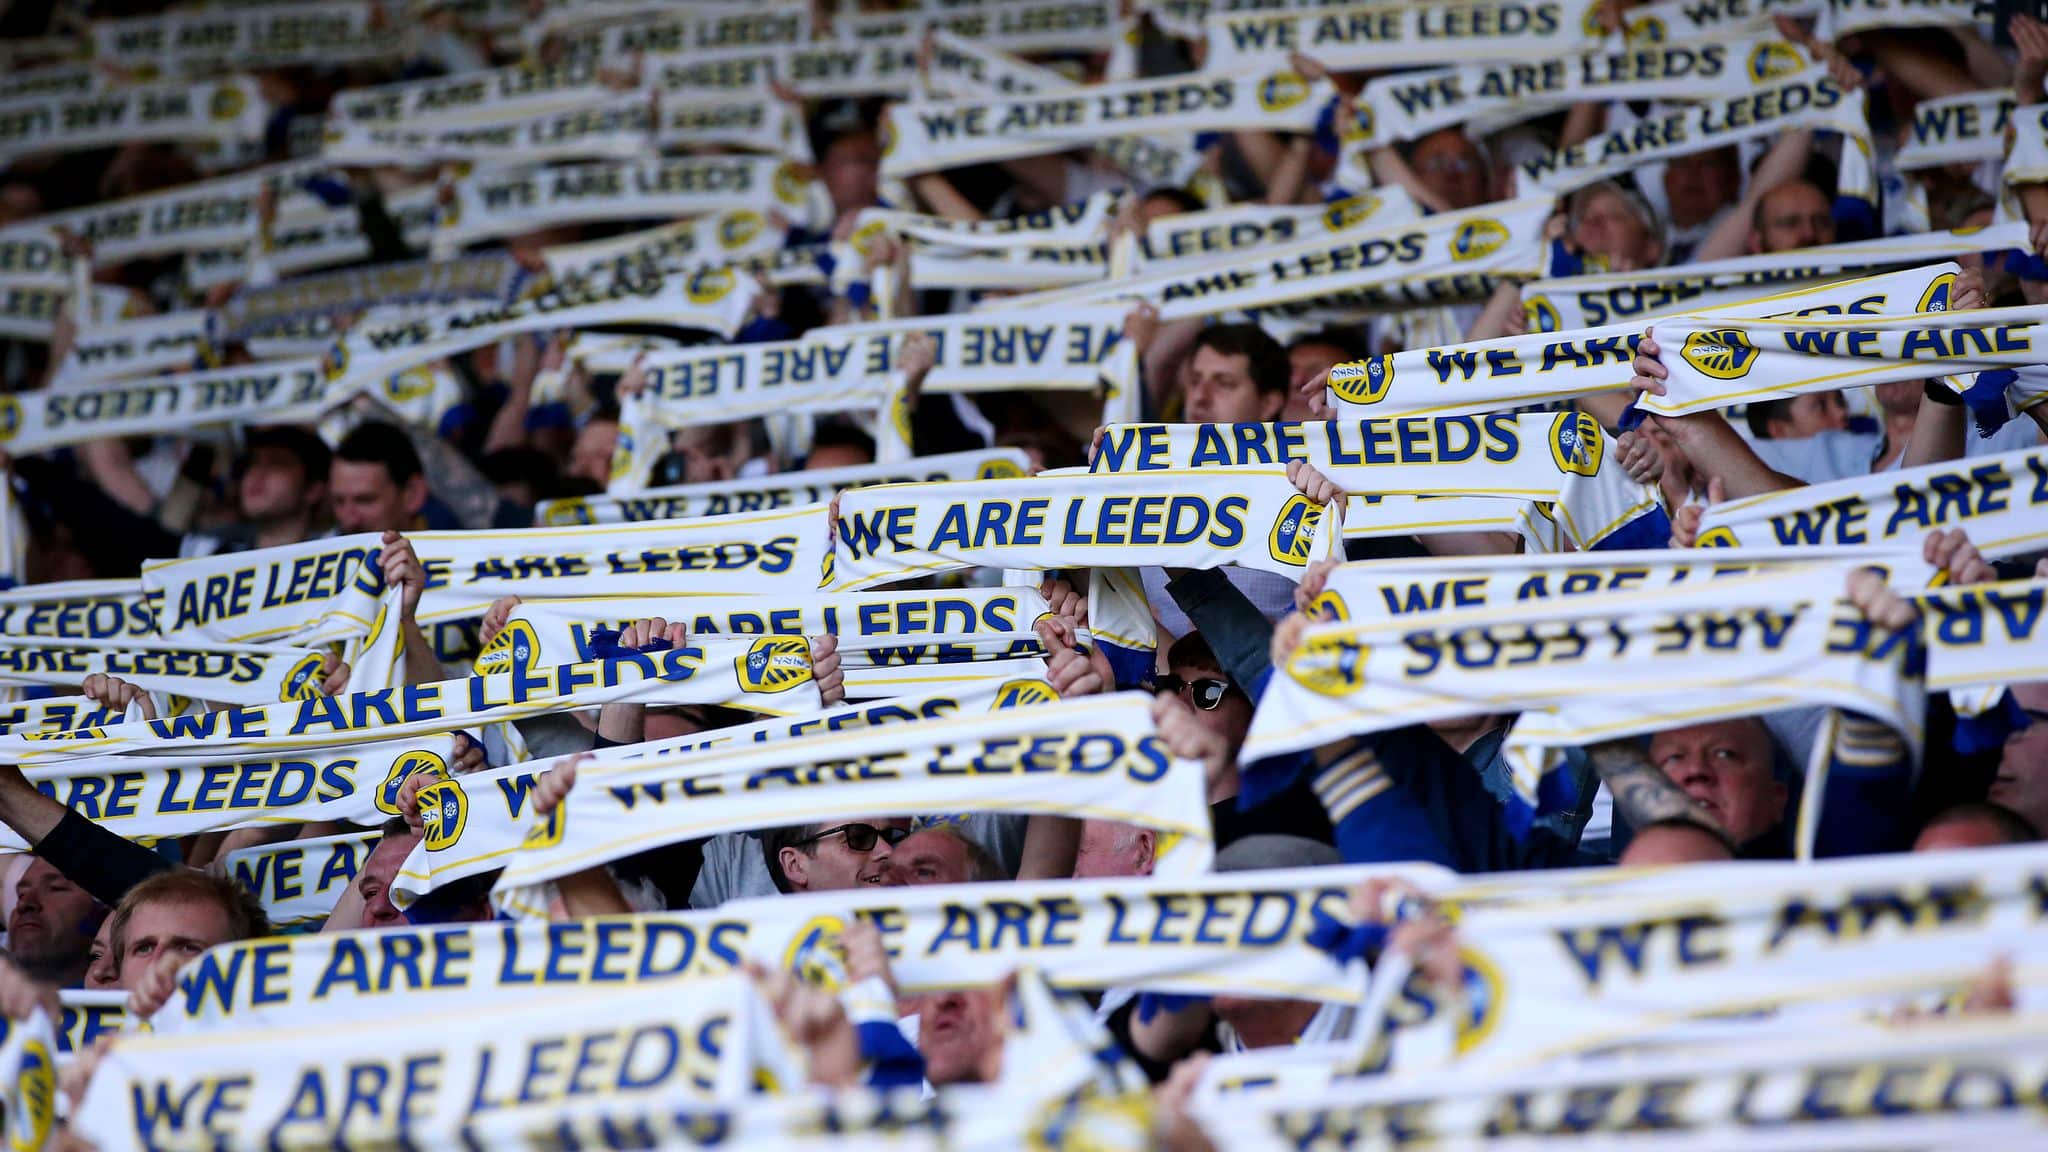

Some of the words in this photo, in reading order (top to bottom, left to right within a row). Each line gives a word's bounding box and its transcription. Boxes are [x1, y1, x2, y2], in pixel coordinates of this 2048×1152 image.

[1230, 20, 1298, 52] WE
[1314, 12, 1402, 45] ARE
[1417, 2, 1563, 39] LEEDS
[1392, 75, 1463, 117] WE
[1476, 57, 1568, 98] ARE
[1582, 44, 1727, 86] LEEDS
[920, 105, 990, 140] WE
[998, 96, 1086, 133] ARE
[1102, 80, 1235, 120] LEEDS
[1523, 147, 1585, 180] WE
[1602, 114, 1687, 163] ARE
[1700, 77, 1842, 135] LEEDS
[1911, 101, 1982, 144] WE
[1270, 232, 1428, 283] LEEDS
[762, 342, 853, 387] ARE
[962, 325, 1055, 368] ARE
[1427, 346, 1525, 385] WE
[1783, 326, 1883, 360] WE
[1899, 322, 2042, 362] ARE
[1090, 424, 1172, 474] WE
[1190, 421, 1309, 468] ARE
[1325, 413, 1523, 466] LEEDS
[838, 505, 920, 562] WE
[927, 497, 1052, 552] ARE
[1061, 493, 1252, 550] LEEDS
[1768, 495, 1868, 546] WE
[1884, 462, 2012, 537] ARE
[464, 552, 594, 583] ARE
[606, 535, 801, 576] LEEDS
[173, 566, 257, 632] ARE
[261, 547, 386, 609] LEEDS
[822, 596, 1018, 637] LEEDS
[1380, 576, 1490, 618] WE
[105, 648, 272, 684] LEEDS
[148, 707, 268, 740] WE
[289, 682, 445, 738] ARE
[465, 645, 706, 715] LEEDS
[156, 758, 360, 814] LEEDS
[926, 733, 1170, 786] LEEDS
[236, 847, 306, 905] WE
[928, 893, 1083, 955] ARE
[1103, 887, 1350, 949] LEEDS
[1555, 910, 1732, 990] WE
[182, 940, 293, 1019] WE
[313, 928, 475, 999] ARE
[499, 918, 752, 986] LEEDS
[133, 1077, 250, 1152] WE
[268, 1054, 444, 1152] ARE
[460, 1015, 728, 1118] LEEDS
[1733, 1062, 2048, 1123] LEED
